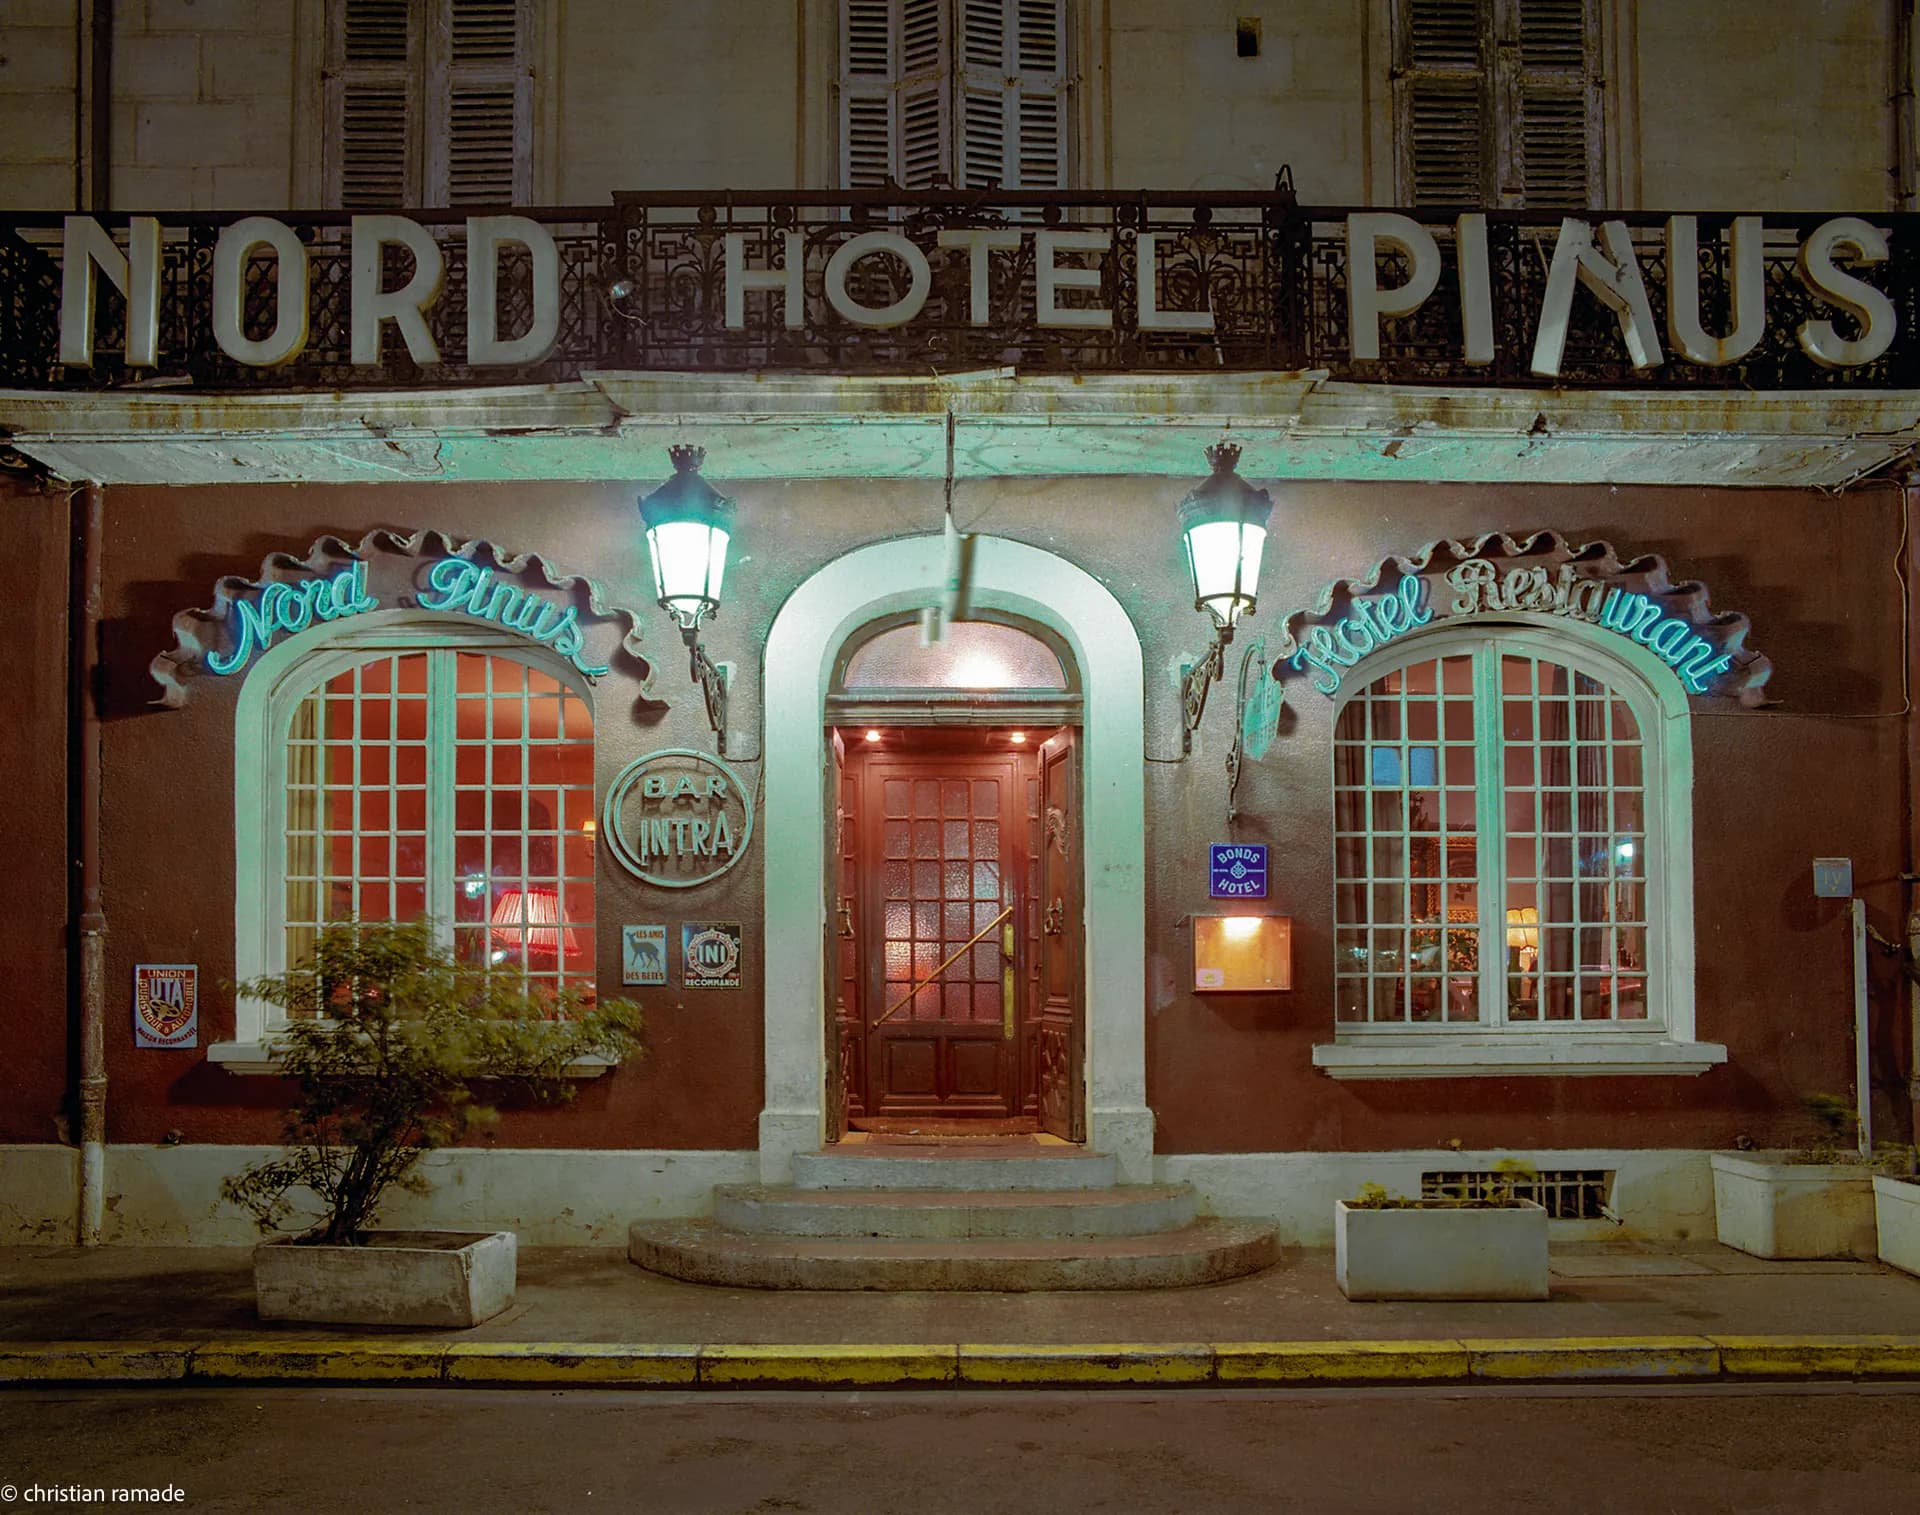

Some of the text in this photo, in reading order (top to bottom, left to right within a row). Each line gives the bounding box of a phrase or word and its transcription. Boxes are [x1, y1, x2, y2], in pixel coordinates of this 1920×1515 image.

[58, 212, 1898, 377] NORD HOTEL PINUS
[206, 557, 609, 677] Nord Pinus
[1290, 558, 1733, 695] Hotel Restaurant
[644, 775, 728, 799] BAR
[641, 810, 734, 866] INTRA
[1217, 848, 1260, 864] BONDS
[1218, 878, 1260, 894] HOTEL
[698, 944, 726, 963] INI
[147, 969, 186, 978] UNION
[150, 978, 184, 1012] UTA
